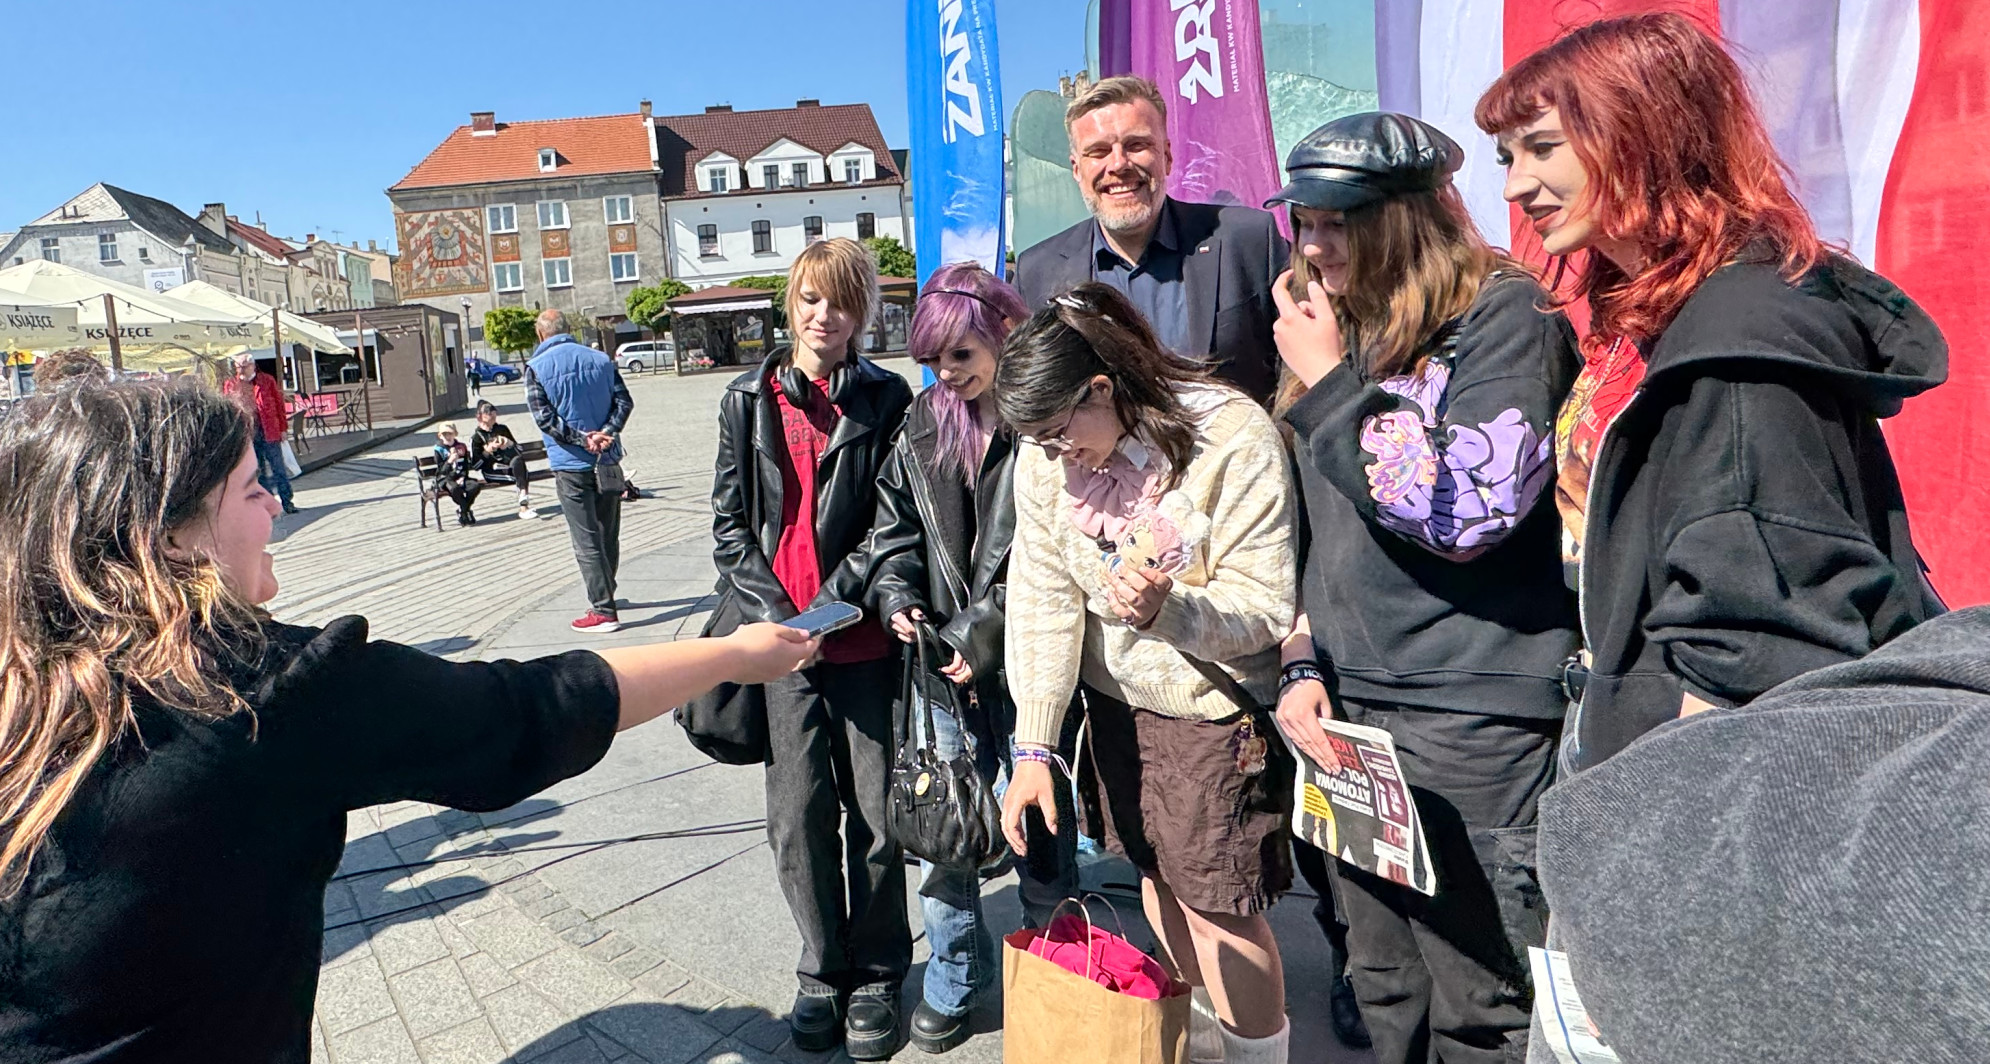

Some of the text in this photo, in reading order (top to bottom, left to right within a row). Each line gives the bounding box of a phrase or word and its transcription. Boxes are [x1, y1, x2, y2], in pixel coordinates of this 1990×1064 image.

[974, 15, 982, 28] NA
[1224, 0, 1233, 30] KANDY
[1227, 32, 1235, 47] KW
[977, 29, 990, 77] KANDYDATA
[986, 78, 993, 92] KW
[85, 325, 154, 340] KSIŻĘCE
[1315, 771, 1371, 804] ATOMOWA
